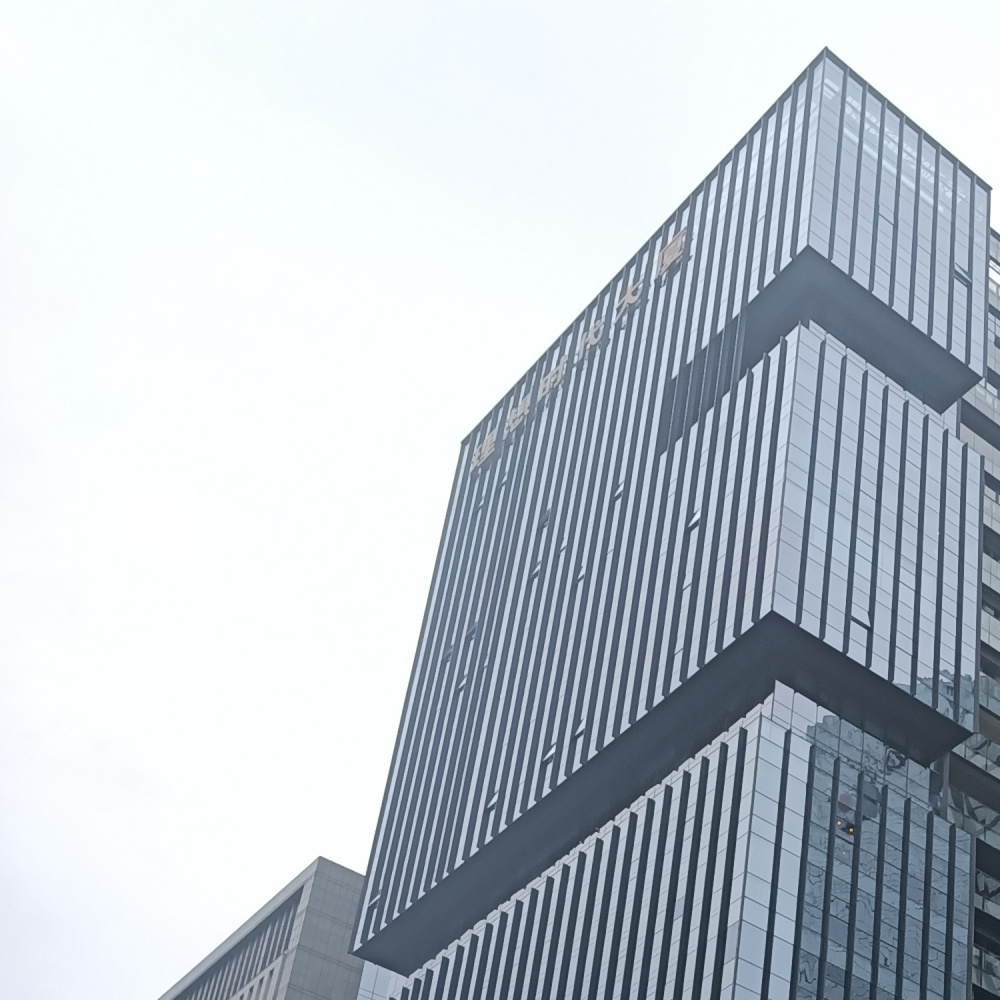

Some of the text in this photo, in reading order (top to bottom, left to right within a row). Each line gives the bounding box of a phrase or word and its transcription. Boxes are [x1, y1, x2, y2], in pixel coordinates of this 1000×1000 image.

[470, 226, 687, 474] 理想时代大厦
